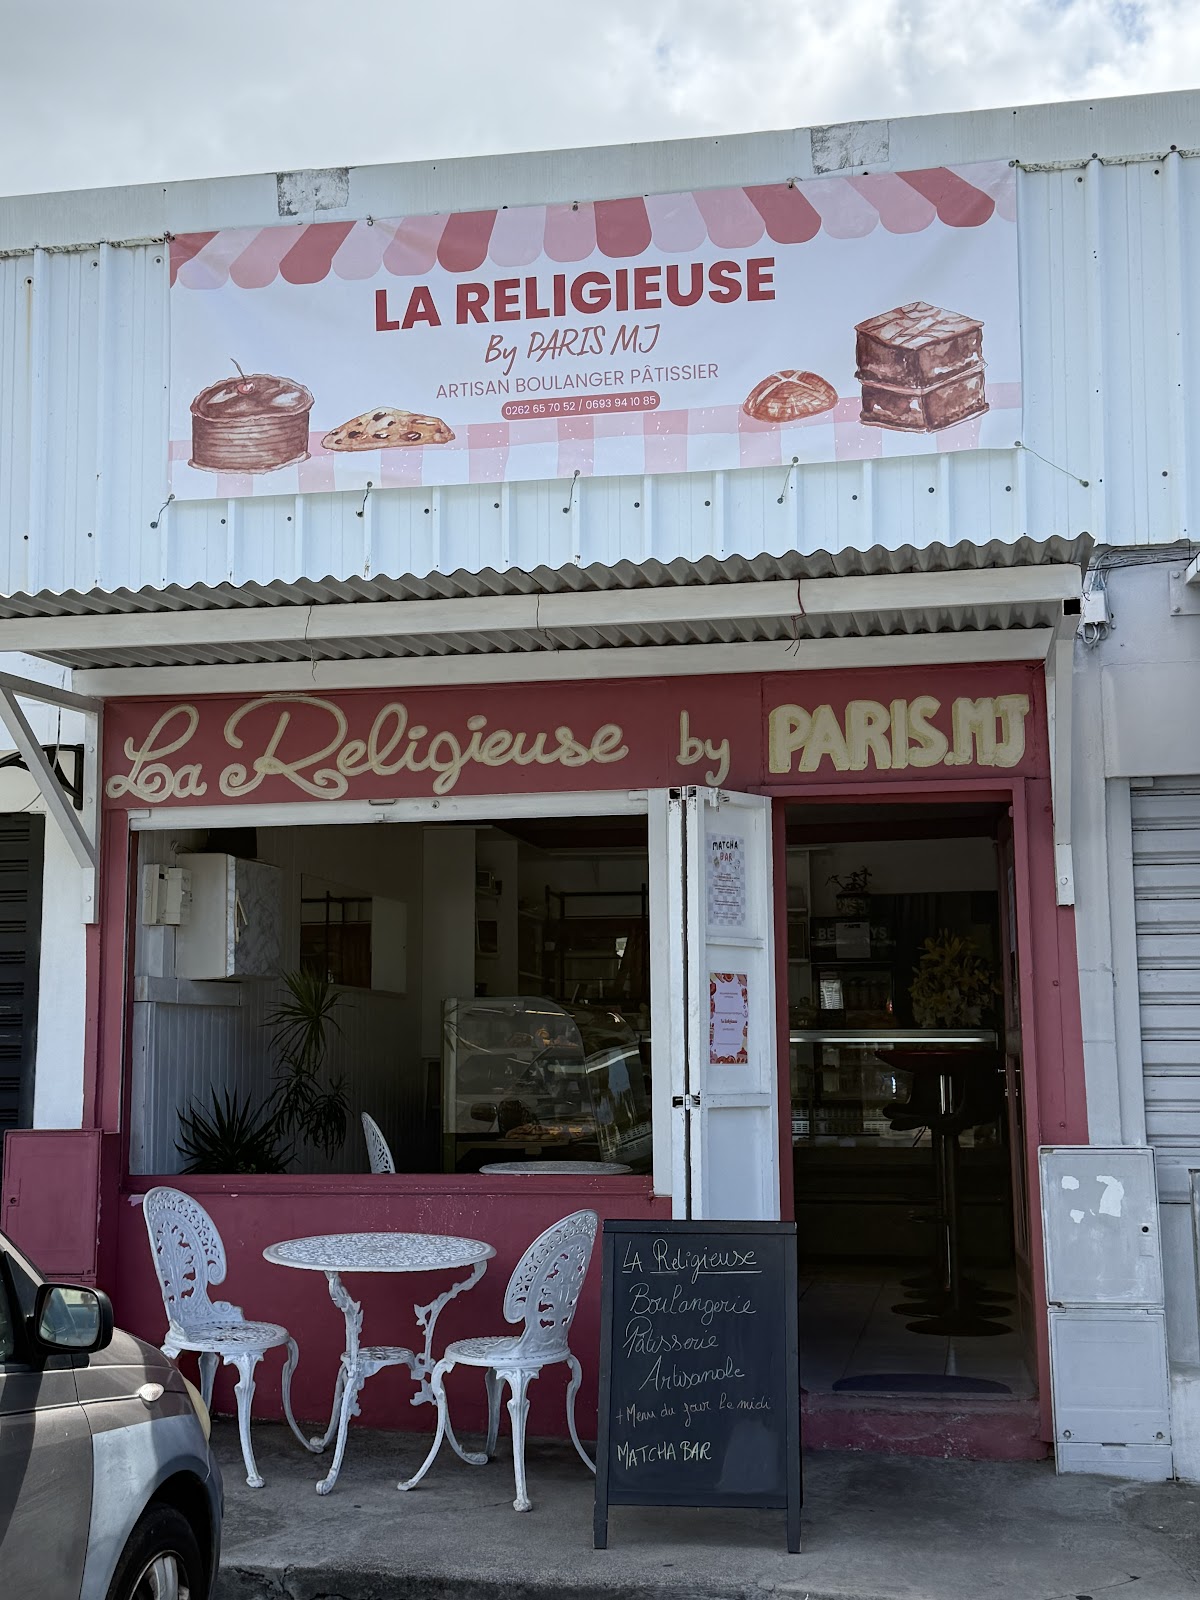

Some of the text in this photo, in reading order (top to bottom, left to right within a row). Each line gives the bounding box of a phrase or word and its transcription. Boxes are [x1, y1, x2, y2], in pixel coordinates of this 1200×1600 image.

[374, 256, 777, 332] LA RELIGIEUSE
[484, 323, 662, 376] By PARIS MJ
[436, 363, 720, 399] ARTISAN BOULANGER PÂTISSIER
[505, 395, 656, 415] 0262 65 70 52 / 0693 94 10 85
[105, 703, 208, 803] La
[219, 693, 629, 799] Religieuse
[676, 709, 731, 787] by
[712, 840, 739, 851] MATCHA
[719, 852, 733, 862] BAR
[622, 1238, 757, 1285] LA Religieuse
[629, 1282, 757, 1326] Boulangerie
[660, 1402, 676, 1418] du
[737, 1395, 771, 1410] midi
[617, 1440, 712, 1470] MATCHA BAR
